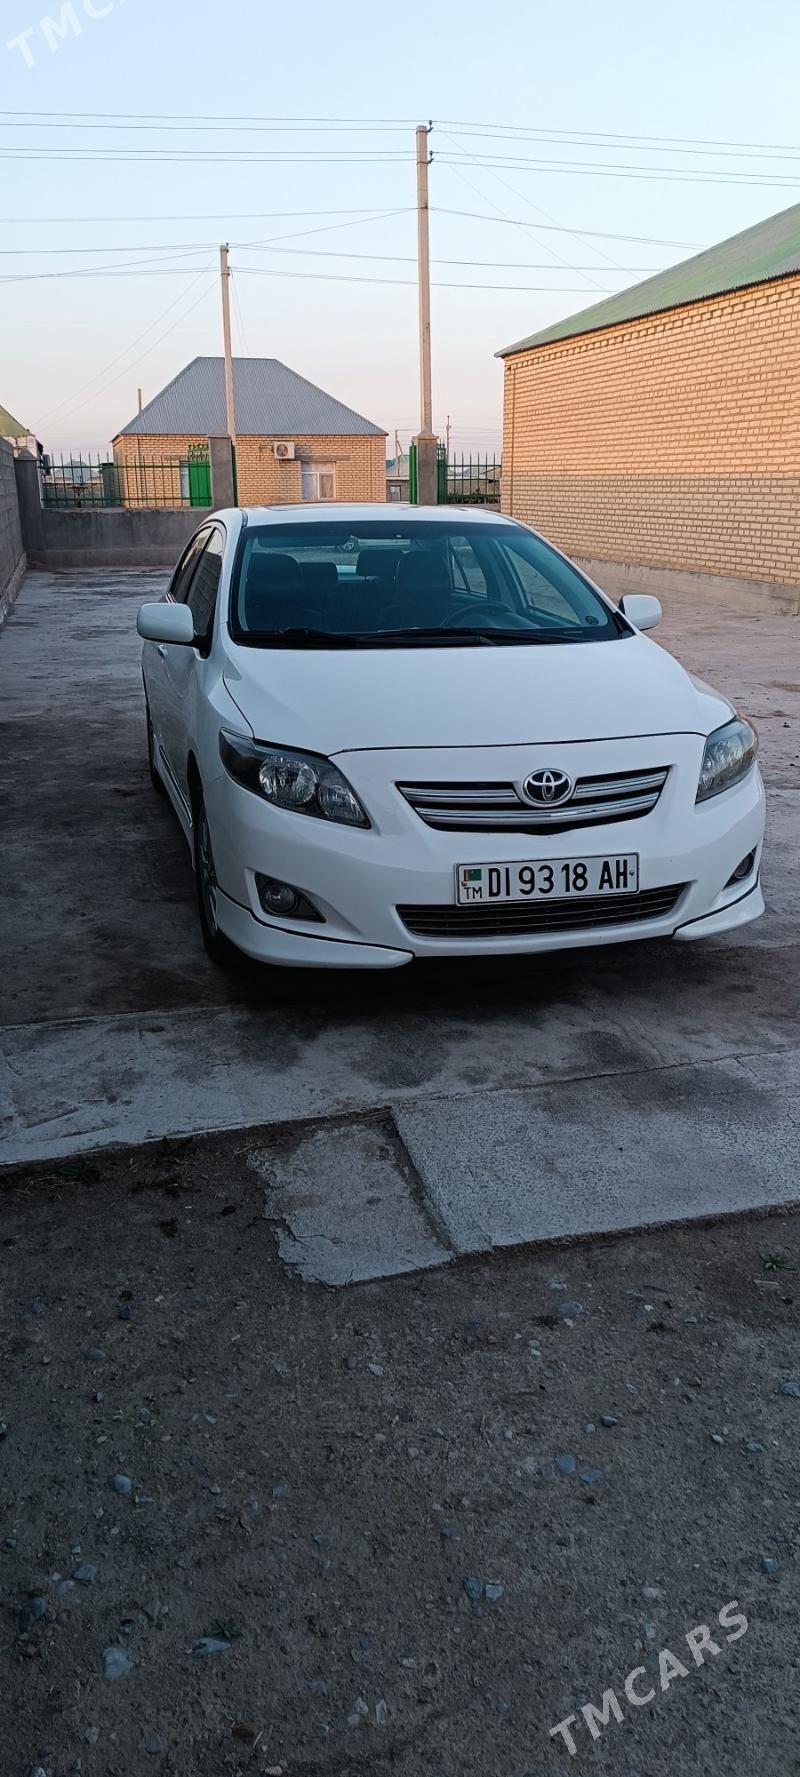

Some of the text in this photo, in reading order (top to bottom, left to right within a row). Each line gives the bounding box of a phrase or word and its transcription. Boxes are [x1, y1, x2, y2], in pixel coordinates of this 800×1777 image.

[488, 867, 511, 897] DI
[598, 859, 628, 890] AH
[464, 886, 482, 900] TM
